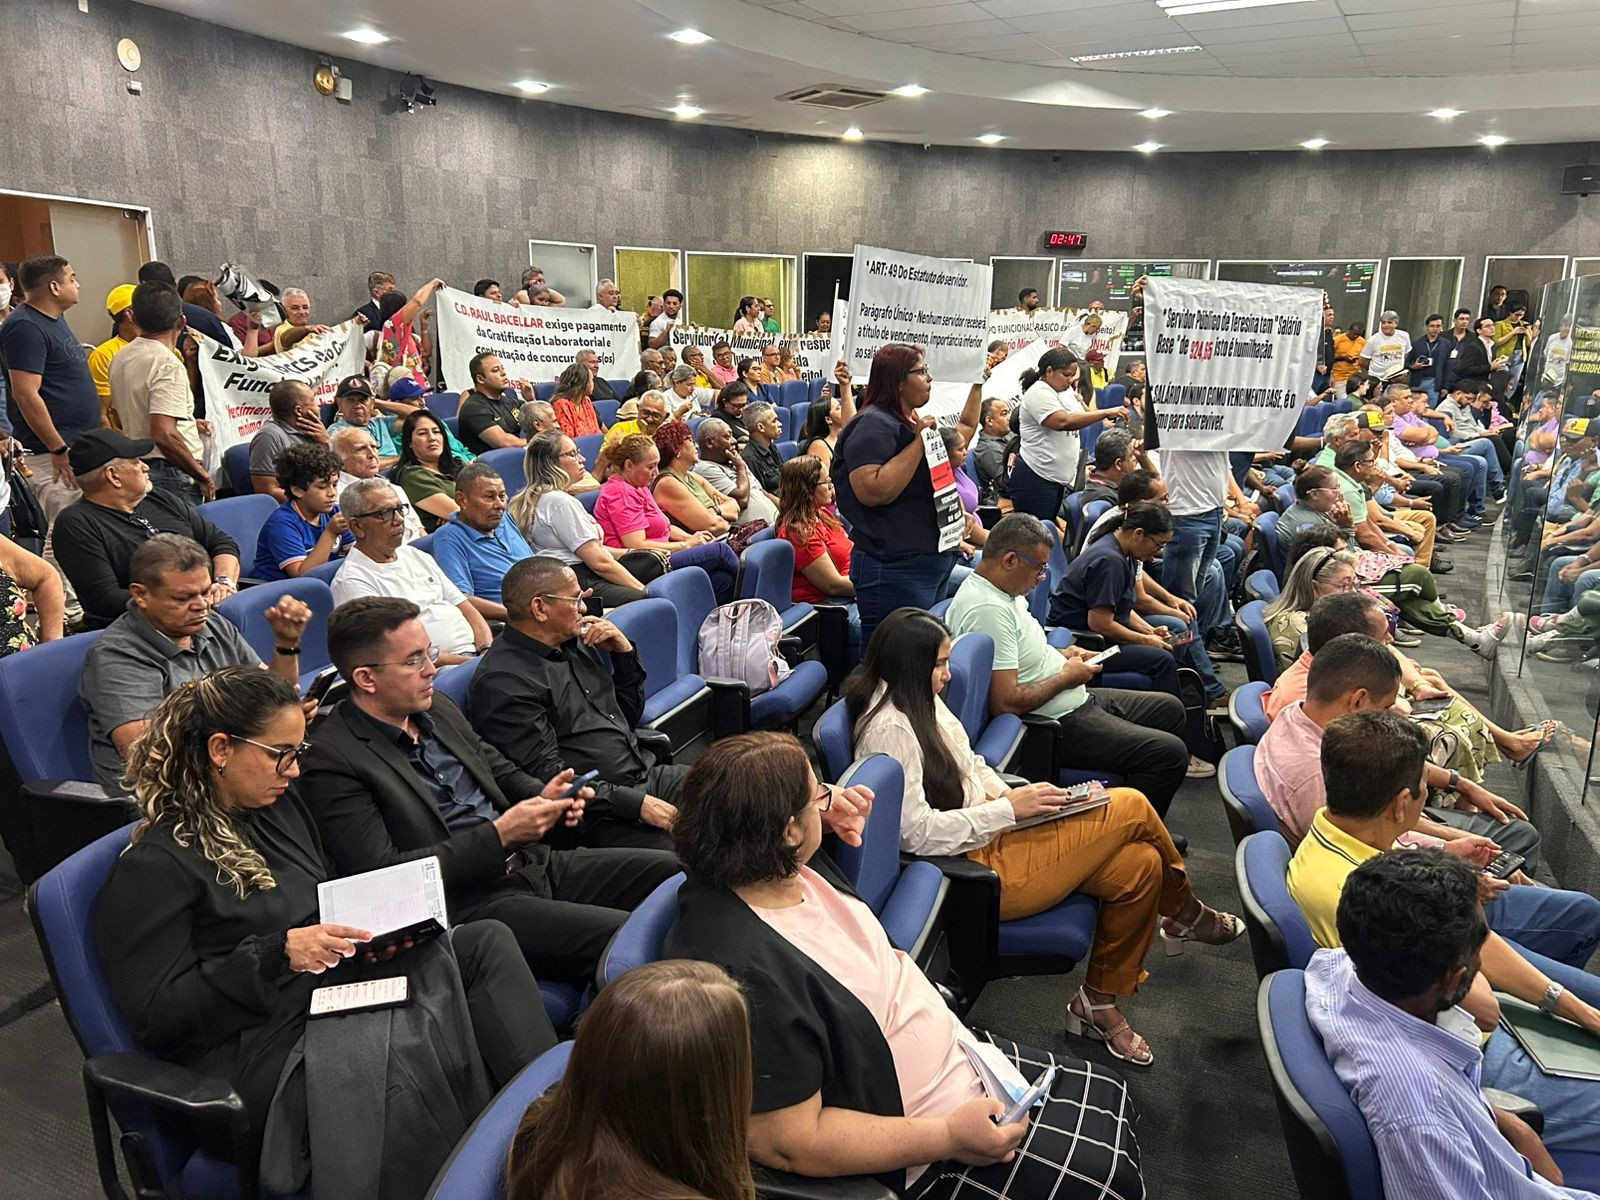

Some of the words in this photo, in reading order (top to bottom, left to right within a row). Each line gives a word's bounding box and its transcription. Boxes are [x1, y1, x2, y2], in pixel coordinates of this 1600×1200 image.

[1051, 233, 1082, 245] 02:47
[870, 260, 888, 277] ART:
[888, 264, 898, 278] 49
[898, 265, 908, 279] Do
[908, 267, 936, 284] Estatuto
[936, 271, 945, 285] do
[944, 272, 969, 288] servidor.
[454, 302, 470, 317] C.D.
[469, 307, 493, 322] RAUL
[493, 312, 544, 329] BACELLAR
[545, 318, 574, 332] exige
[575, 321, 627, 333] pagamento
[860, 302, 893, 321] Parágrafo
[893, 303, 913, 322] Único
[916, 309, 942, 325] Nenhum
[942, 313, 964, 327] servidor
[1166, 308, 1196, 329] Servidor
[1195, 310, 1220, 331] Público
[1220, 310, 1231, 332] de
[1230, 312, 1259, 333] Teresina
[1259, 316, 1274, 334] tem
[476, 325, 487, 338] da
[486, 327, 542, 348] Gratificação
[542, 335, 605, 347] Laboratorial
[606, 340, 612, 348] e
[857, 326, 862, 337] a
[862, 323, 880, 339] título
[880, 325, 890, 340] de
[890, 329, 929, 346] vencimento,
[929, 331, 963, 348] importância
[962, 334, 983, 348] inferior
[998, 322, 1033, 334] FUNCIONAL
[527, 350, 539, 362] de
[855, 347, 863, 358] ao
[1156, 334, 1174, 354] Base
[1213, 337, 1227, 356] isto
[1227, 337, 1234, 357] é
[1233, 338, 1273, 362] humilhação.
[1153, 381, 1181, 404] SALÁRIO
[1180, 382, 1206, 406] MÍNIMO
[1206, 386, 1227, 407] COMO
[1226, 387, 1265, 408] VENCIMENTO
[1265, 389, 1283, 410] BASE,
[1283, 390, 1291, 408] é
[1290, 393, 1296, 409] o
[1167, 413, 1186, 432] para
[1184, 411, 1225, 431] sobreviver.
